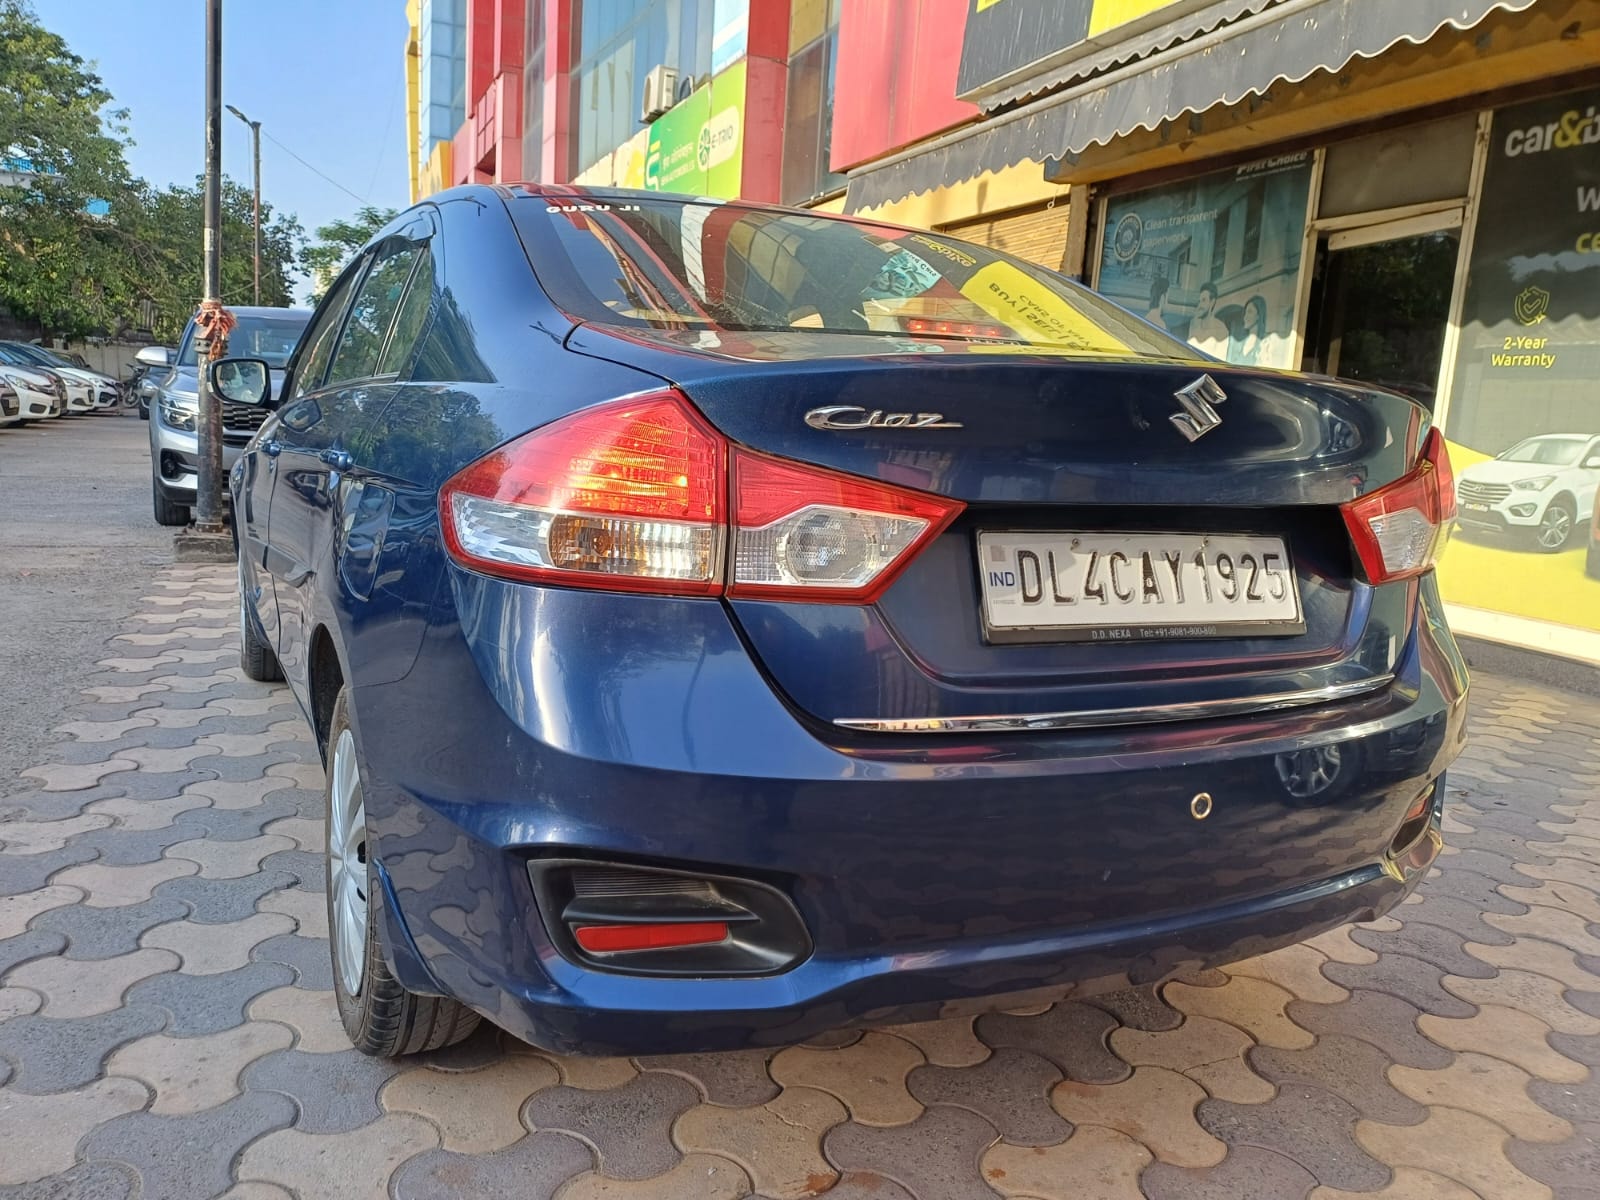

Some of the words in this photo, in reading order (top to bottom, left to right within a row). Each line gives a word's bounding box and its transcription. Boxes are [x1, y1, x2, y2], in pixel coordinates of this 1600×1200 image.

[545, 204, 611, 214] GURU
[1144, 219, 1167, 231] Clean
[1169, 209, 1218, 225] transparent
[1503, 335, 1549, 350] 2-Year
[1491, 353, 1556, 369] Warranty
[804, 405, 964, 430] Ciaz
[989, 571, 1015, 587] IND
[1109, 629, 1131, 639] NEXA
